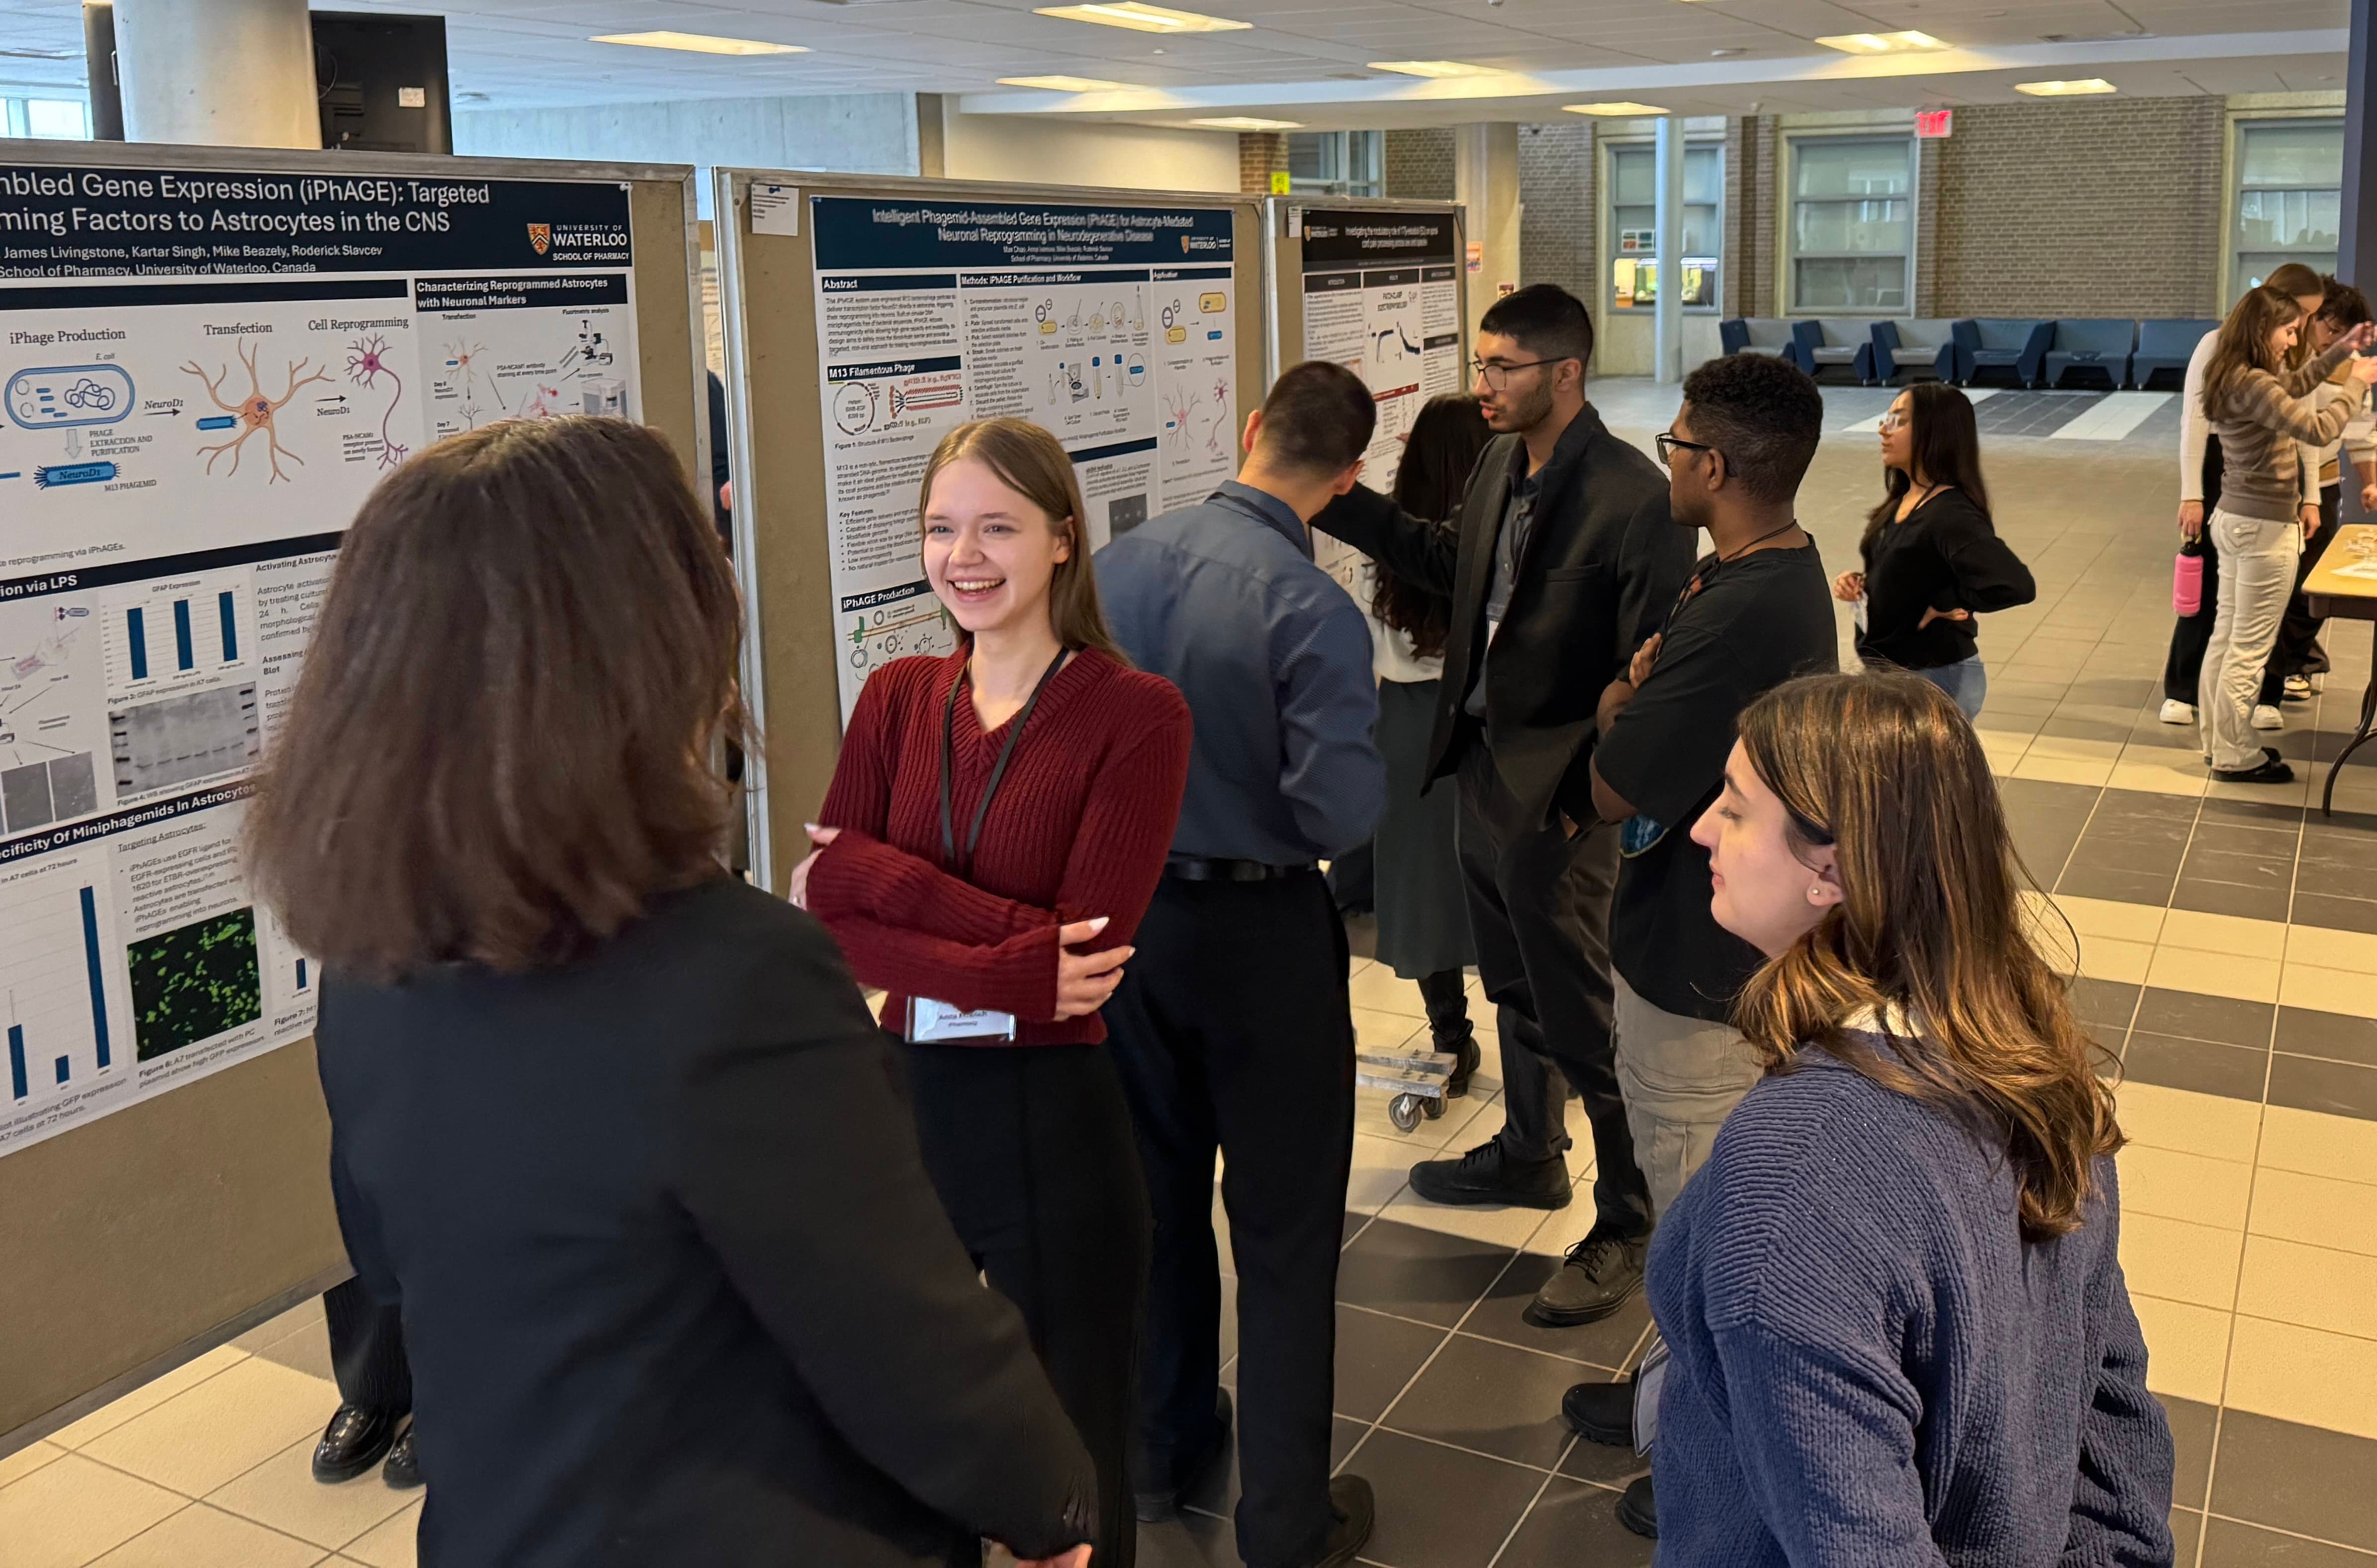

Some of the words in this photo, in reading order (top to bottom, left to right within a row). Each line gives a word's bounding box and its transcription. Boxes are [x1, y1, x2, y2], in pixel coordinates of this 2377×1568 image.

[82, 173, 154, 197] Gene
[161, 175, 293, 203] Expression
[300, 179, 404, 206] (iPhAGE):
[408, 182, 489, 207] Targeted
[0, 207, 67, 236] ming
[72, 208, 172, 231] Factors
[178, 211, 204, 231] to
[211, 209, 335, 236] Astrocytes
[340, 211, 360, 232] in
[365, 211, 400, 231] the
[406, 211, 450, 232] CNS
[872, 208, 920, 226] Intelligent
[1019, 212, 1042, 226] Gene
[553, 233, 627, 247] WATERLOO
[938, 227, 980, 242] Neuronal
[980, 227, 1047, 245] Reprogramming
[4, 247, 48, 258] James
[51, 246, 129, 260] Livingstone,
[132, 246, 169, 257] Kartar
[172, 246, 210, 259] Singh,
[213, 246, 240, 256] Mike
[244, 246, 290, 258] Beazely,
[292, 245, 341, 256] Roderick
[553, 252, 581, 261] SCHOOL
[0, 265, 45, 277] School
[48, 265, 61, 277] of
[64, 265, 133, 276] Pharmacy,
[136, 264, 196, 275] University
[200, 263, 211, 273] of
[272, 262, 316, 272] Canada
[417, 281, 489, 293] Characterizing
[491, 279, 560, 292] Reprogrammed
[562, 278, 608, 289] Astrocytes
[824, 279, 858, 289] Abstract
[990, 276, 1012, 284] iPhAGE
[418, 298, 439, 308] with
[442, 296, 487, 307] Neuronal
[489, 295, 526, 305] Markers
[204, 322, 272, 335] Transfection
[308, 320, 328, 331] Cell
[330, 317, 409, 331] Reprogramming
[9, 331, 54, 345] iPhage
[58, 329, 126, 342] Production
[829, 368, 847, 378] M13
[144, 399, 184, 410] NeuroD1
[89, 429, 114, 438] PHAGE
[59, 468, 101, 480] NeuroD1
[8, 550, 74, 566] reprogramming
[256, 559, 297, 572] Activating
[26, 580, 47, 593] via
[50, 575, 78, 589] LPS
[257, 583, 294, 595] Astrocyte
[843, 596, 876, 608] iPhAGE
[263, 666, 280, 675] Blot
[108, 695, 129, 705] Figure
[54, 830, 71, 844] Of
[74, 805, 174, 839] Miniphagemids
[177, 801, 189, 812] In
[118, 835, 158, 853] Targeting
[134, 897, 172, 913] Astrocytes
[139, 1063, 164, 1078] Figure
